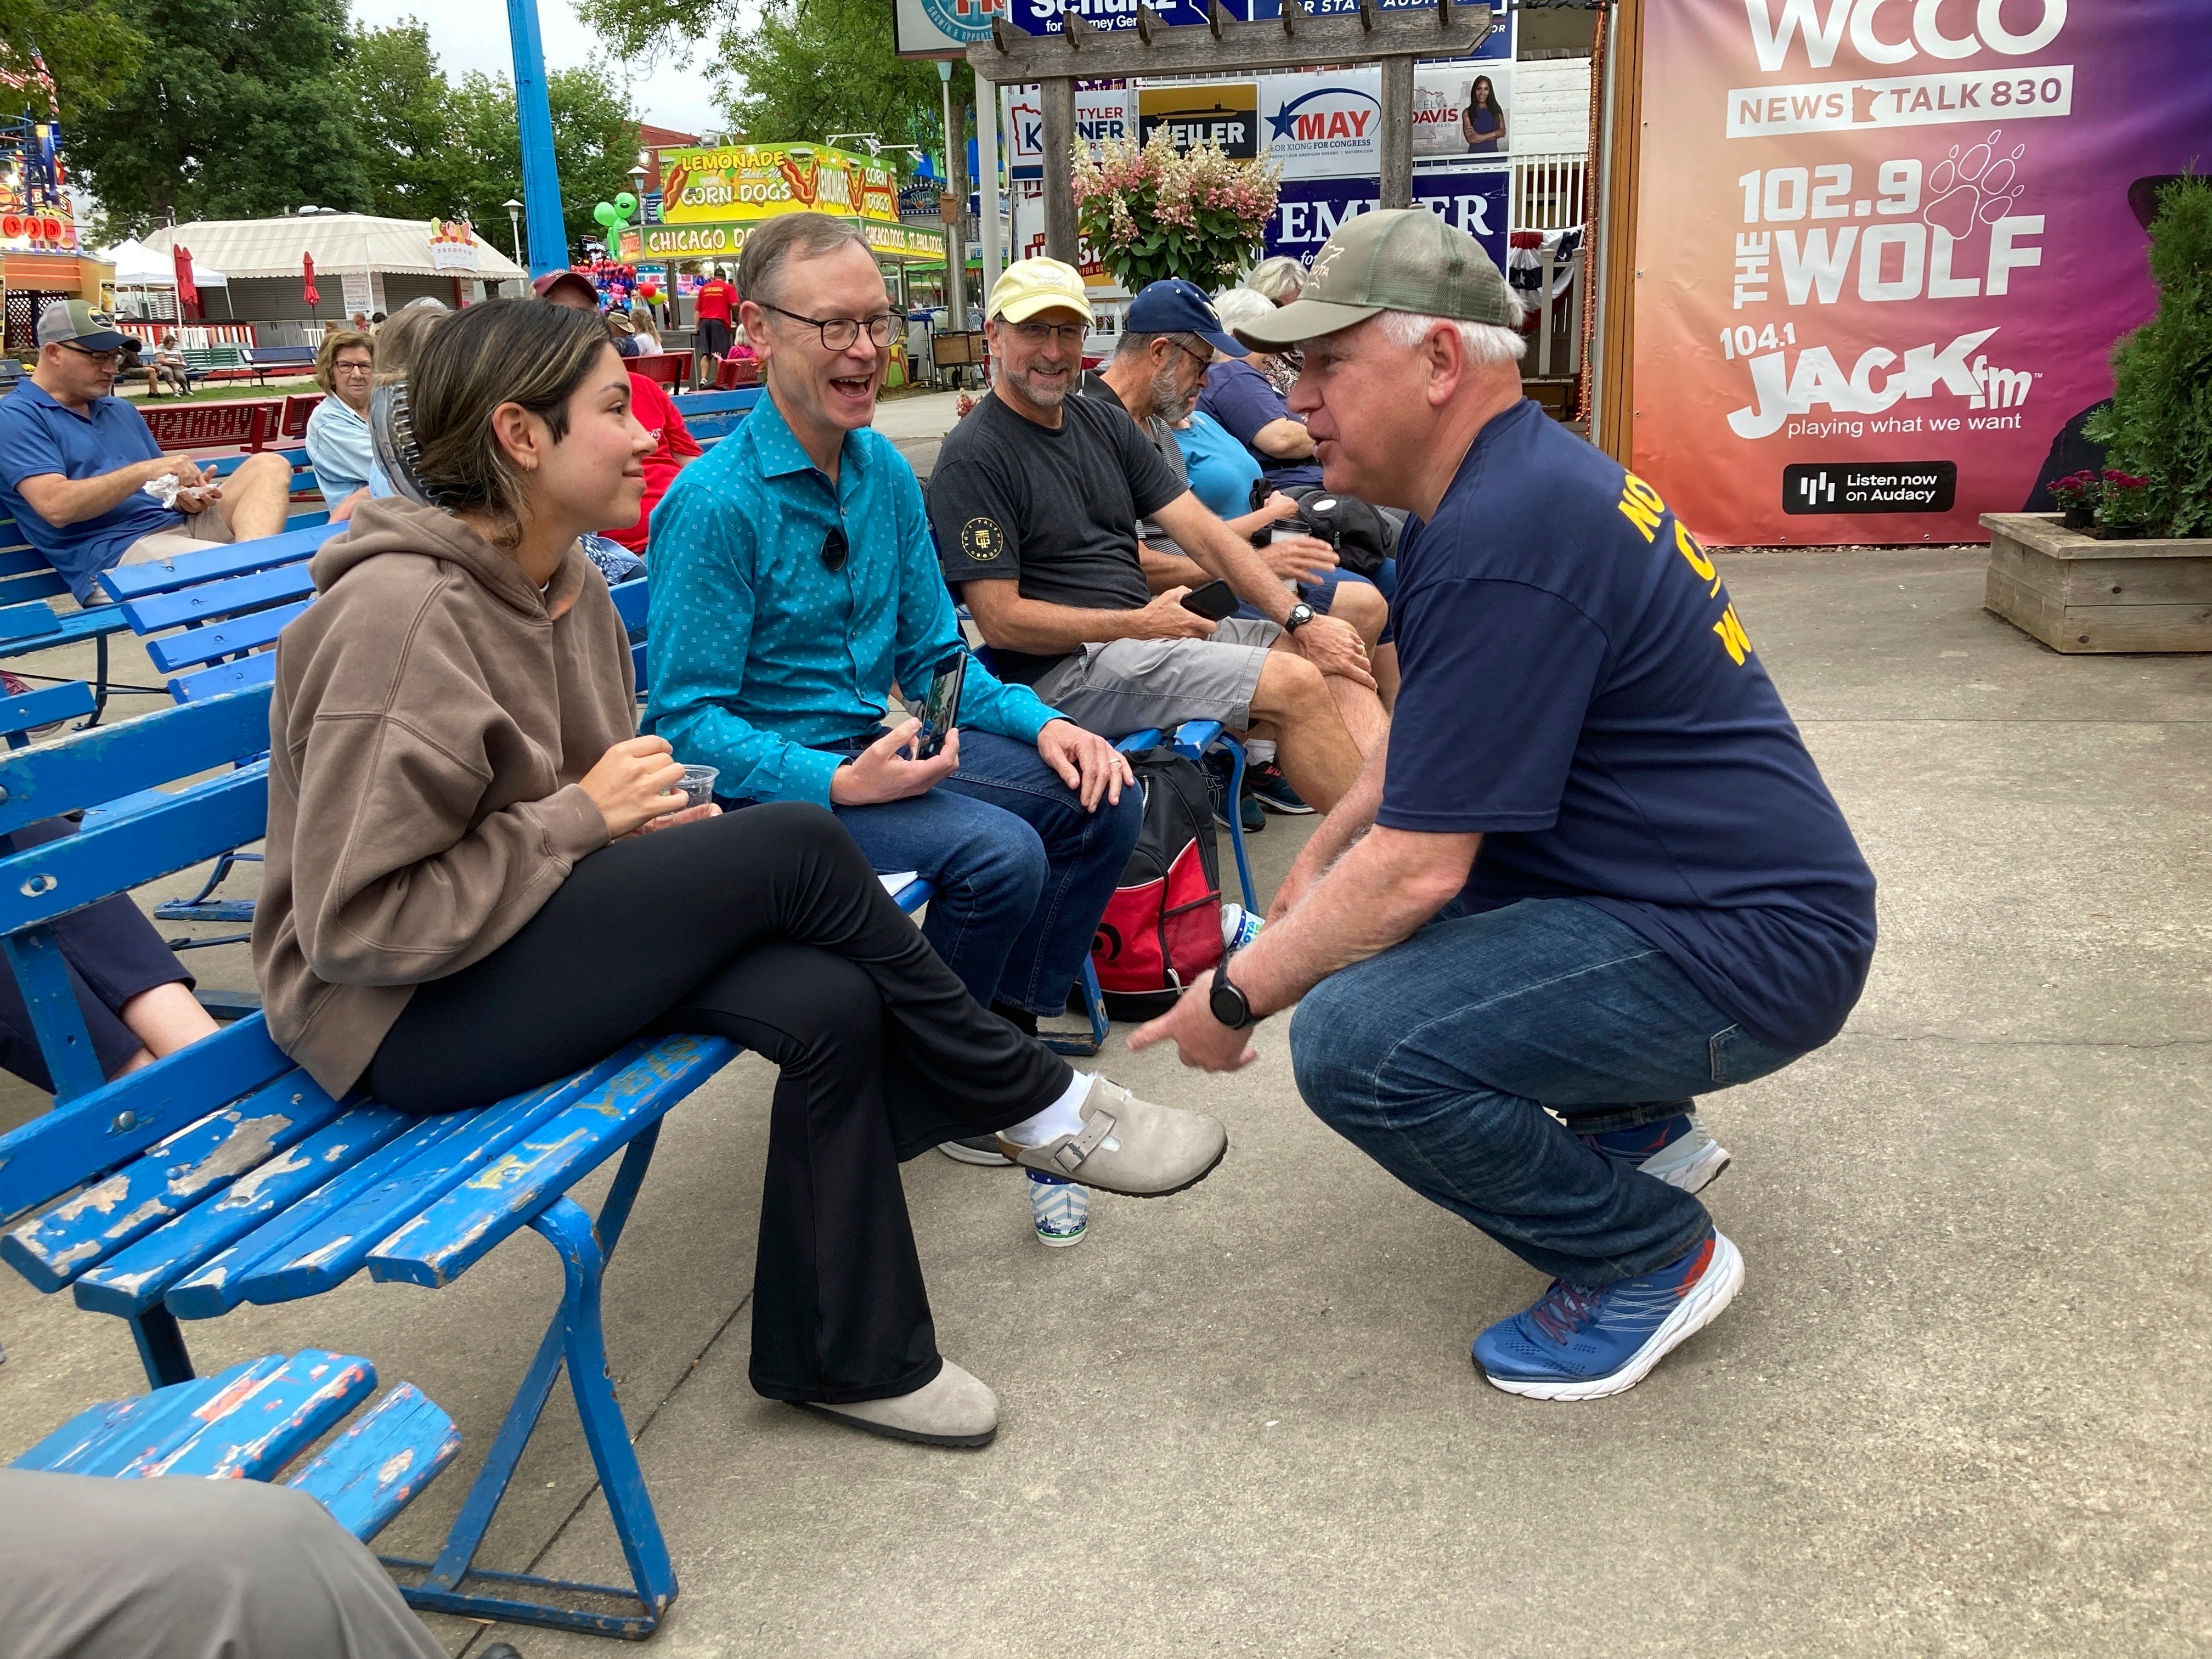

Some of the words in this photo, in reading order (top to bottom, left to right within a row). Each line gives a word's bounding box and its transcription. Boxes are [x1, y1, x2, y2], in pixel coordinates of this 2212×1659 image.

[927, 6, 951, 33] GROWTH
[962, 30, 994, 41] OPPORTU
[1046, 20, 1063, 32] for
[1747, 0, 2068, 71] WCCO
[1077, 106, 1124, 120] TYLER
[1415, 99, 1442, 110] CELY
[1740, 94, 1844, 125] NEWS
[1891, 82, 1983, 113] TALK
[1991, 78, 2062, 106] 830
[1146, 122, 1245, 146] WEILER
[1298, 110, 1372, 141] MAY
[1287, 143, 1312, 151] XIONG
[1330, 139, 1371, 148] CONGRESS
[682, 150, 786, 172] LEMONADE
[739, 167, 782, 180] Shake-Up
[865, 166, 888, 186] CORN
[680, 185, 733, 207] CORN
[739, 180, 792, 204] DOGS
[867, 193, 889, 212] DOGS
[1739, 159, 1922, 223] 102.9
[3, 216, 61, 240] OOD
[1277, 195, 1494, 244] EMER
[437, 247, 472, 256] PRODUCE
[649, 228, 726, 252] CHICAGO
[866, 225, 889, 247] CHICAGO
[889, 228, 905, 250] DOGS
[916, 232, 929, 252] PAUL
[929, 235, 943, 255] DOGS
[1734, 231, 1771, 309] THE
[1775, 215, 2045, 306] WOLF
[1719, 322, 1796, 360] 104.1
[1788, 416, 1864, 438] playing
[1870, 414, 1923, 433] what
[1929, 417, 1961, 432] we
[1968, 412, 2022, 430] want
[1847, 472, 1898, 487] Listen
[1901, 473, 1938, 486] now
[1846, 490, 1867, 500] on
[1870, 488, 1936, 504] Audacy
